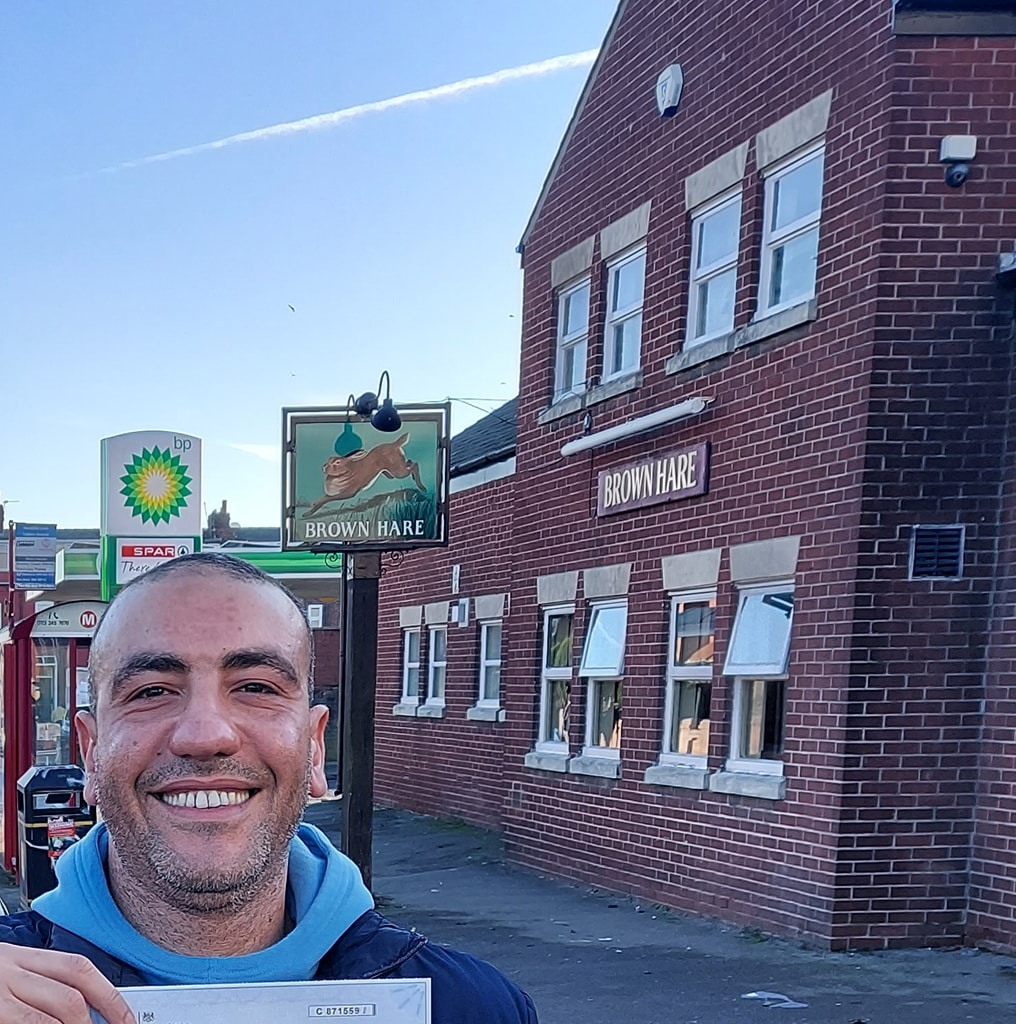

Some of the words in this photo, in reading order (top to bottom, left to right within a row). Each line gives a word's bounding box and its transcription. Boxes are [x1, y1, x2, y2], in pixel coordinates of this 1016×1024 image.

[174, 436, 192, 452] bp
[604, 463, 654, 509] BROWN
[656, 451, 698, 496] HARE
[305, 521, 369, 538] BROWN
[378, 520, 425, 537] HARE
[134, 547, 175, 556] SPAR
[82, 614, 95, 626] M
[316, 1008, 323, 1016] C
